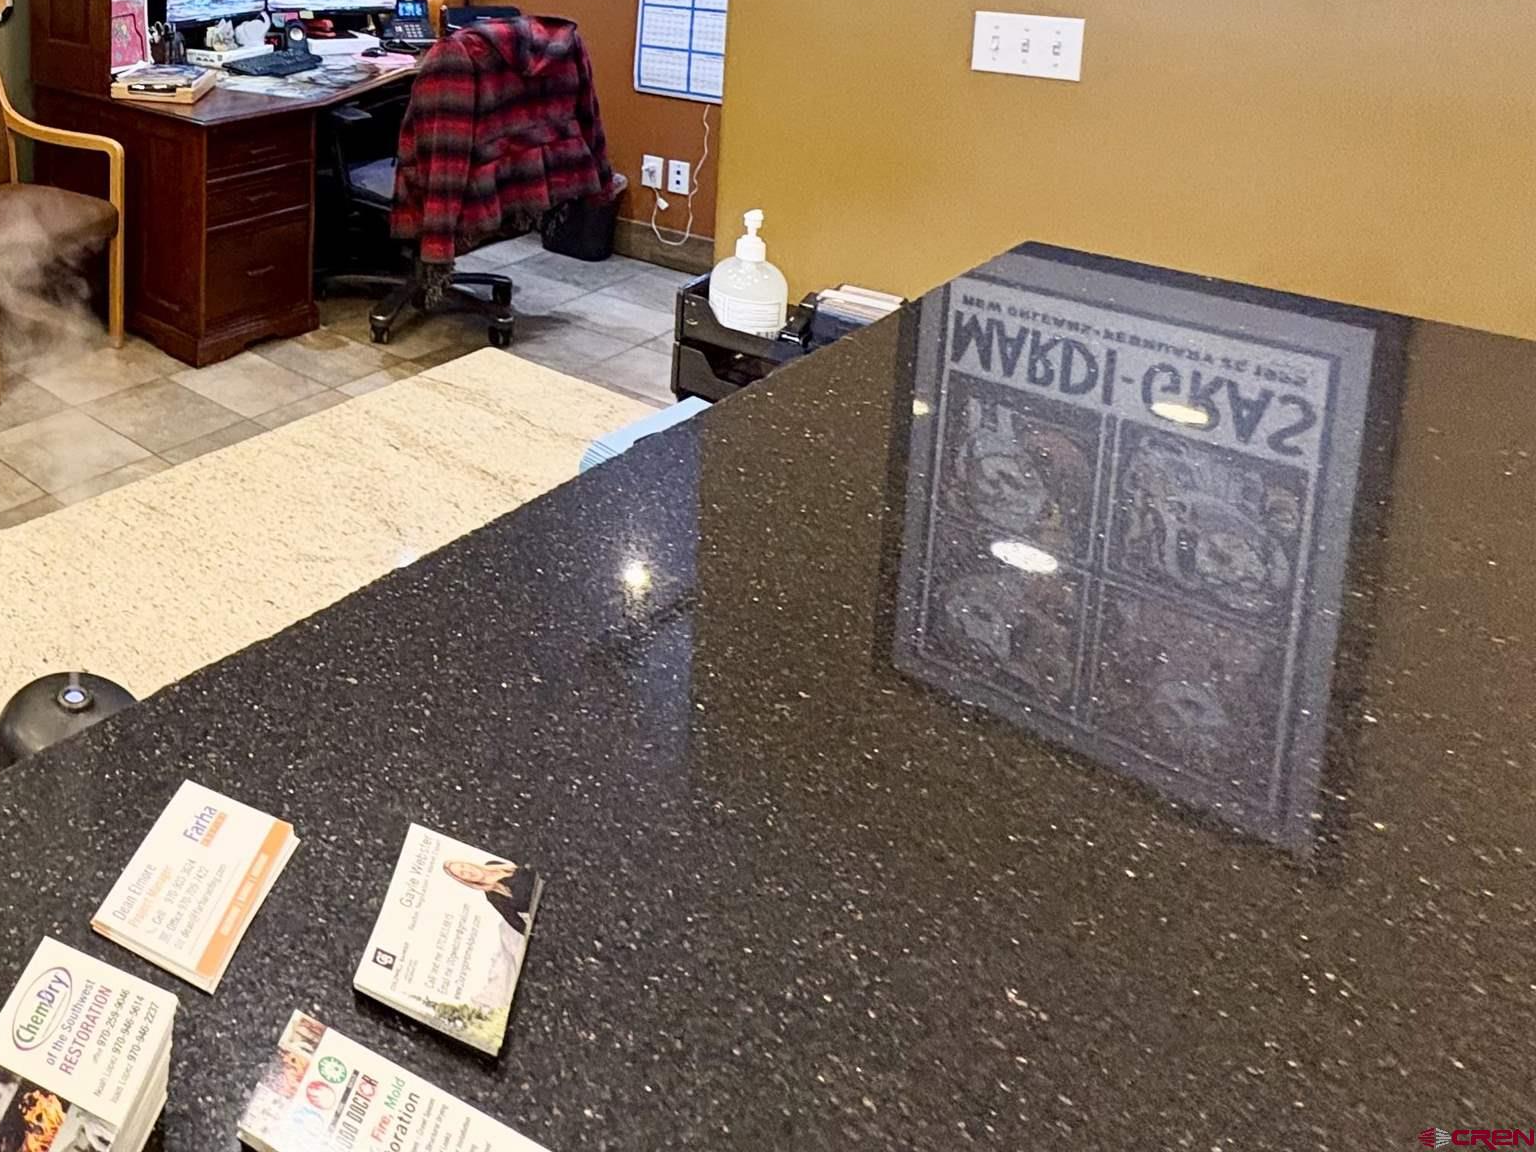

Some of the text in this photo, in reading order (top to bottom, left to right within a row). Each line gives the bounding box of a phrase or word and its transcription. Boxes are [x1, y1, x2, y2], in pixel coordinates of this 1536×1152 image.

[182, 805, 218, 843] Farha
[399, 879, 420, 908] Gayle
[46, 978, 97, 1066] of the Southwest
[59, 985, 113, 1075] RESTORATION
[383, 1076, 406, 1111] Mold
